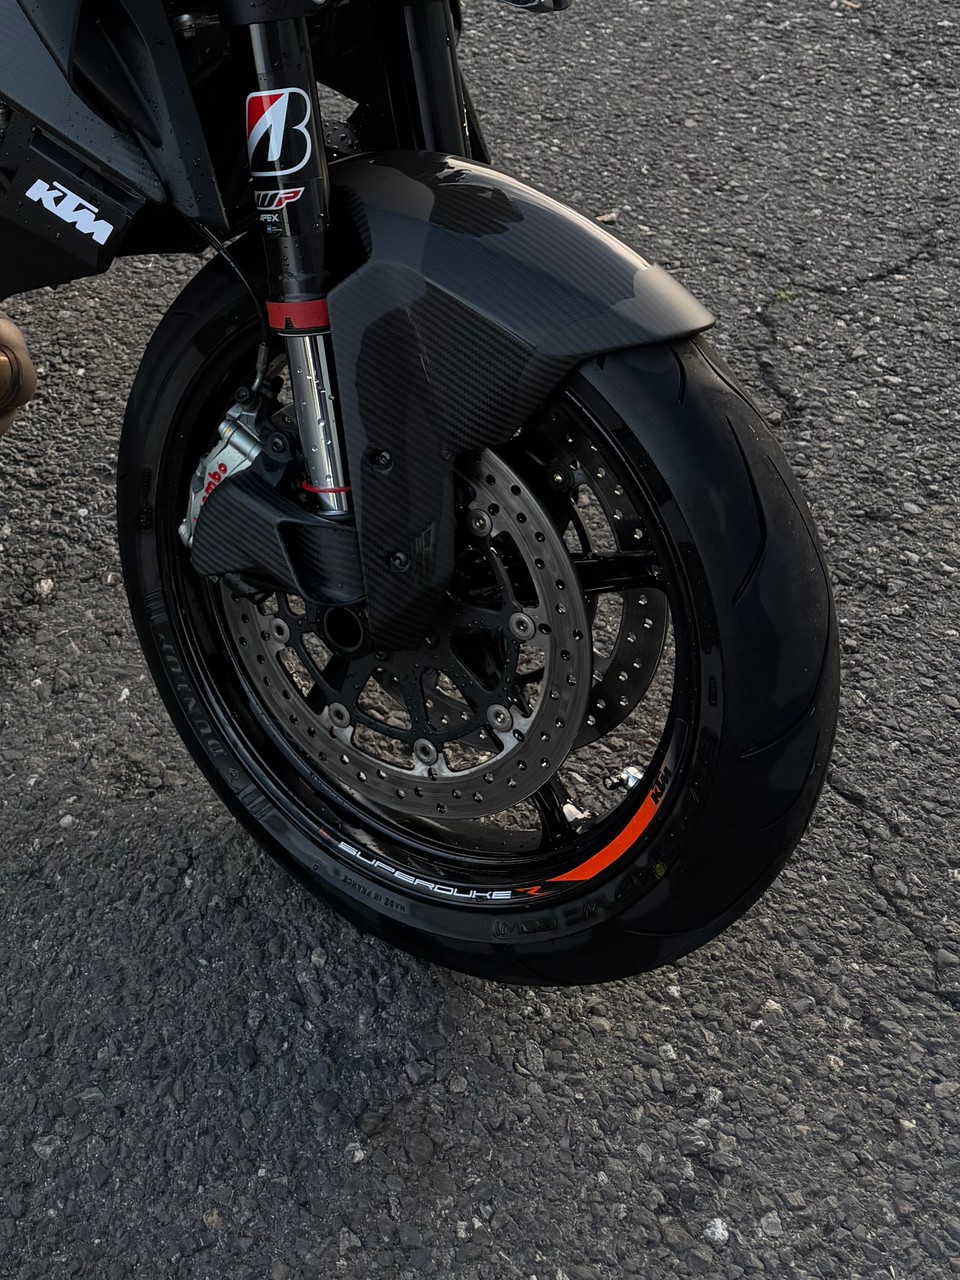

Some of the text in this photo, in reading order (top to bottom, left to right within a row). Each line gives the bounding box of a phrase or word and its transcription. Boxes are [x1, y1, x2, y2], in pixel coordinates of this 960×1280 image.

[25, 178, 114, 245] KTM
[254, 187, 305, 210] WP
[650, 766, 672, 806] KTM
[338, 841, 512, 900] SUPERDUKE
[341, 873, 373, 898] FRANCE
